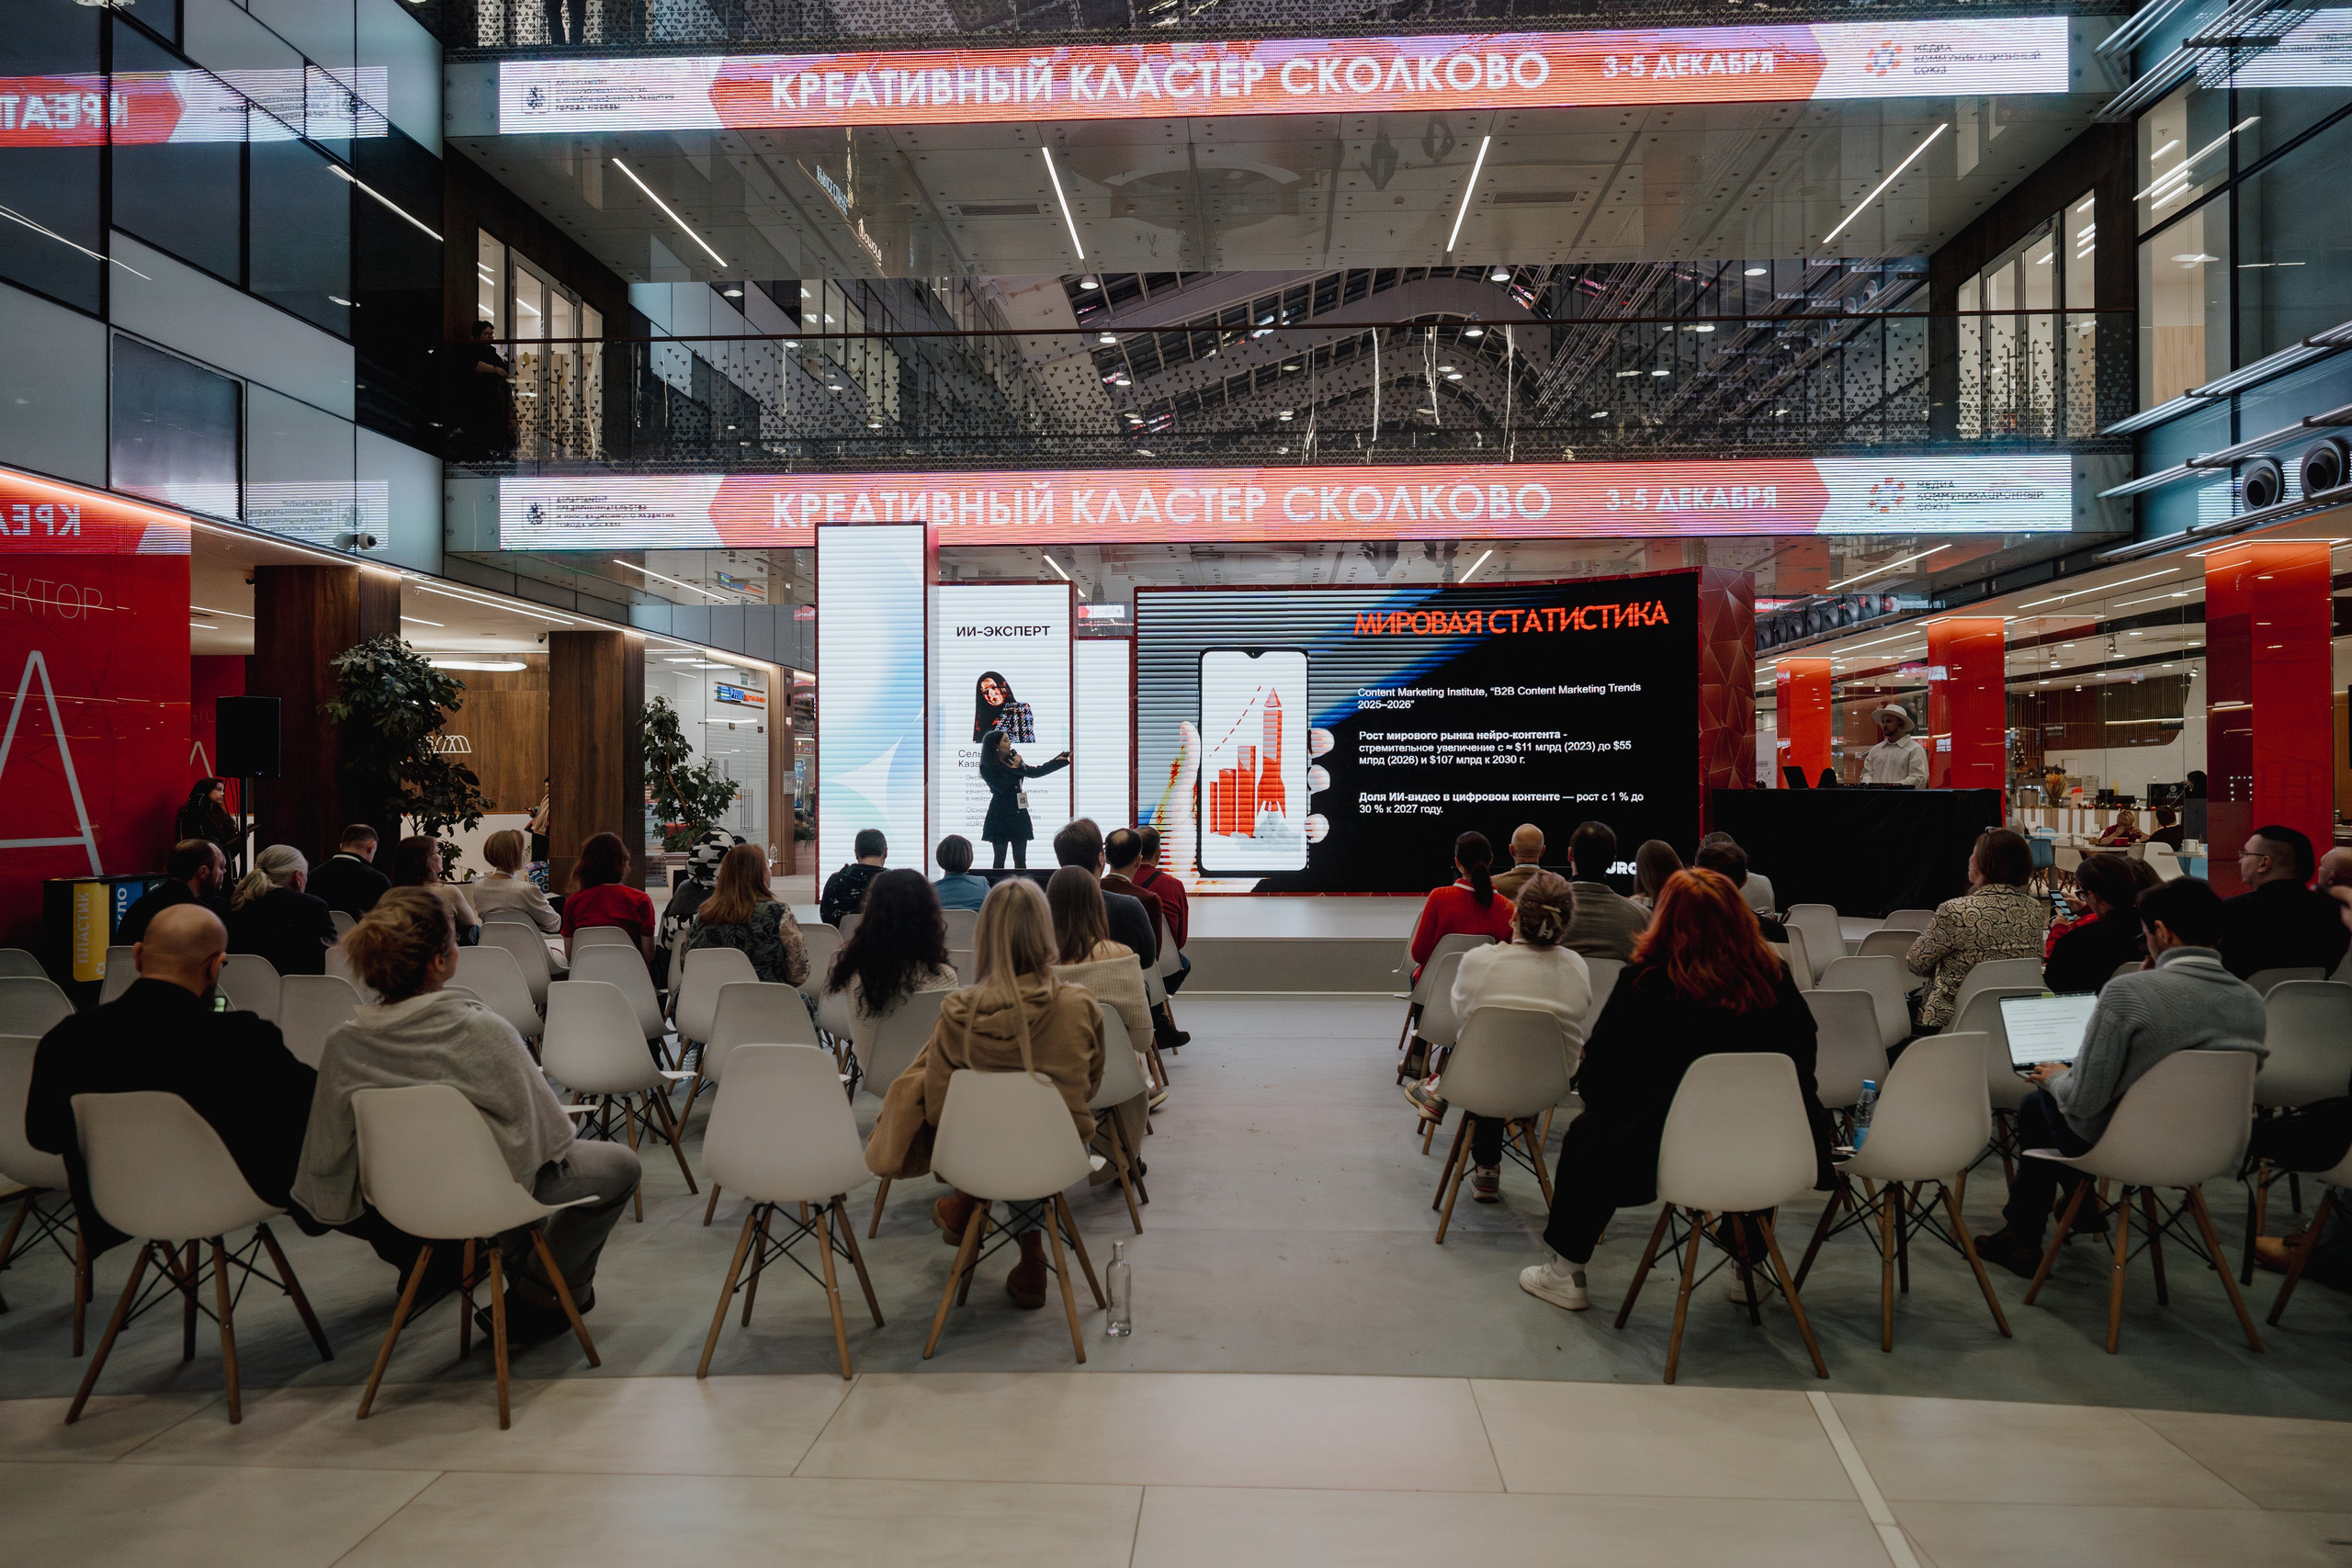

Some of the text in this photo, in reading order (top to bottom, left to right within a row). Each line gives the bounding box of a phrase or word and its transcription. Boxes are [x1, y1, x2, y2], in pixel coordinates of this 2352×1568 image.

[1602, 51, 1775, 79] 3-5 ДЕКАБРЯ
[771, 51, 1551, 109] КРЕАТИВНЫЙ КЛАСТЕР СКОЛКОВО
[773, 481, 1553, 527] КРЕАТИВНЫЙ КЛАСТЕР СКОЛКОВО
[1606, 486, 1778, 513] 3-5 ДЕКАБРЯ
[1353, 600, 1669, 636] МИРОВАЯ СТАТИСТИКА
[956, 626, 1050, 637] ИИ-ЭКСПЕРТ
[1358, 688, 1396, 697] Content
[1397, 687, 1444, 699] Marketing
[1447, 686, 1488, 698] Institute,
[1518, 685, 1555, 695] Content
[1558, 684, 1606, 695] Marketing
[1608, 682, 1641, 693] Trends
[1359, 731, 1385, 740] Рост
[1386, 732, 1438, 741] мирового
[1441, 732, 1474, 741] рынка
[1476, 730, 1561, 740] нейро-контента
[1359, 744, 1434, 754] стремительное
[1437, 744, 1496, 753] увеличение
[1515, 742, 1532, 752] $11
[1535, 744, 1562, 753] млрд
[1564, 741, 1596, 752] (2023)
[1598, 743, 1611, 752] до
[1612, 740, 1632, 750] $55
[1359, 757, 1385, 766] млрд
[1387, 755, 1419, 766] (2026)
[1430, 755, 1453, 765] $107
[1456, 756, 1482, 765] млрд
[1493, 755, 1516, 764] 2030
[1358, 793, 1386, 803] Доля
[1389, 793, 1441, 803] ИИ-видео
[1453, 793, 1510, 804] цифровом
[1577, 794, 1599, 803] рост
[1619, 792, 1629, 801] %
[1631, 794, 1644, 803] до
[1360, 805, 1372, 813] 30
[1374, 805, 1384, 813] %
[1394, 805, 1418, 813] 2027
[1420, 806, 1443, 815] году.
[76, 892, 90, 964] ПЛАСТИК
